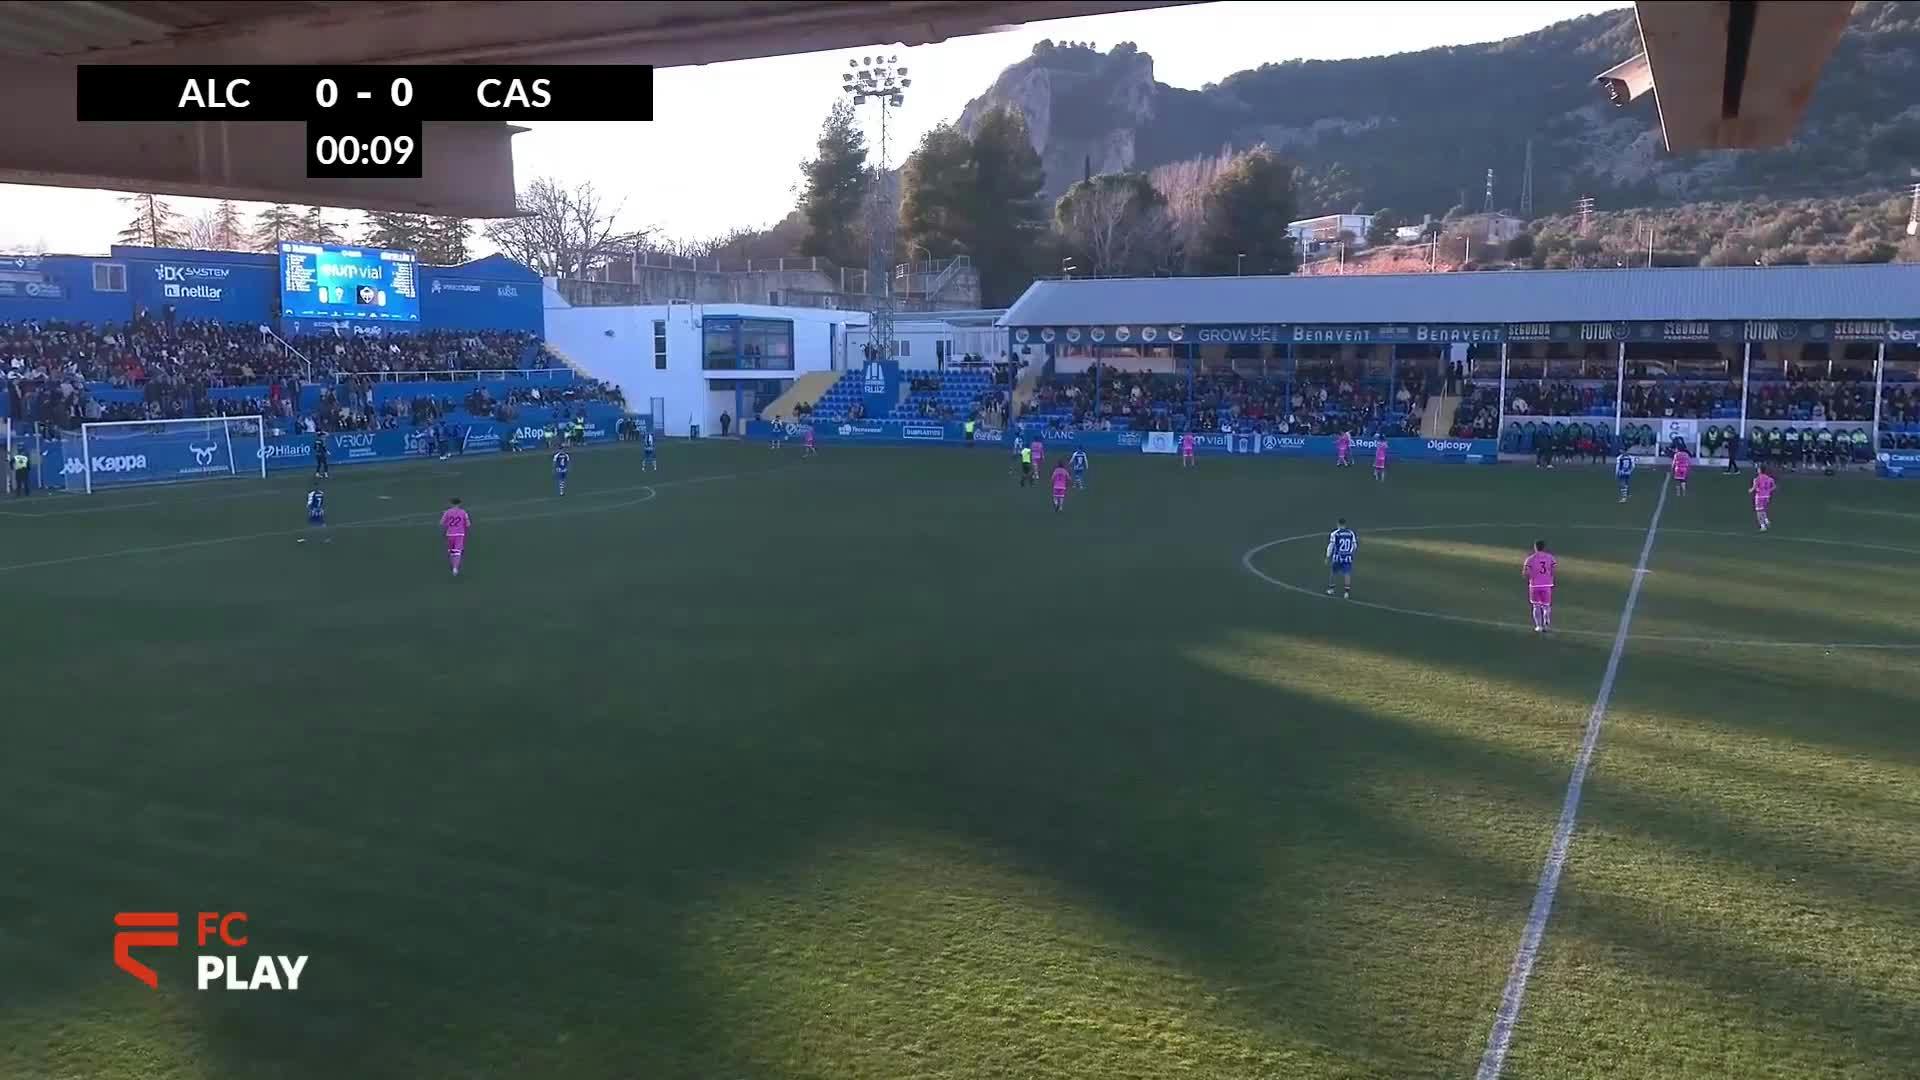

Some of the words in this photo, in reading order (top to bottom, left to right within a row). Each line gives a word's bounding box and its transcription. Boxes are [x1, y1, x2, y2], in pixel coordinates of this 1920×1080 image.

[185, 267, 230, 278] SYSTEM
[1199, 328, 1247, 342] GROW
[92, 454, 147, 473] Kappa
[1339, 538, 1351, 552] 20
[1539, 560, 1547, 575] 3
